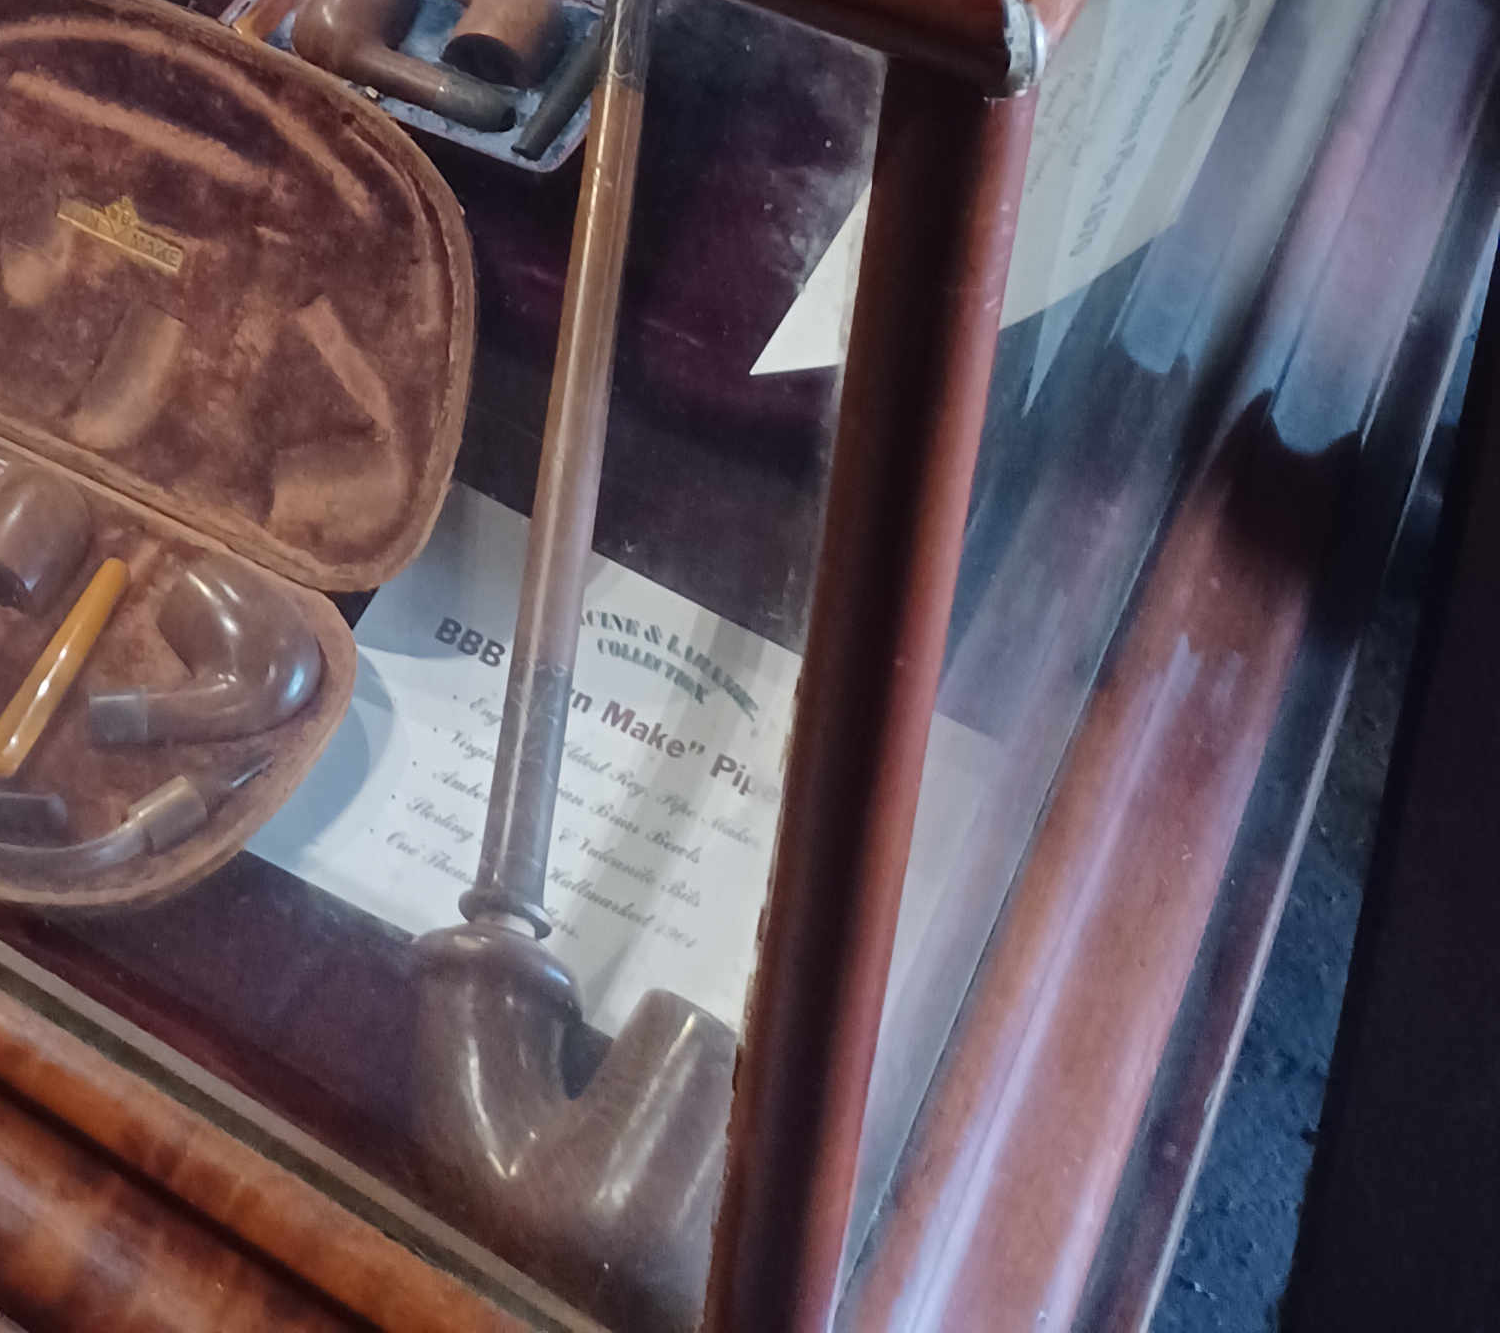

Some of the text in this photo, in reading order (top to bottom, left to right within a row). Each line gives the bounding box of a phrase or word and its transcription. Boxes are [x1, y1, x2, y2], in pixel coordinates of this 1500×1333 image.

[434, 616, 507, 669] BBB
[597, 637, 709, 706] COLLECTION
[644, 620, 662, 644] &
[667, 633, 760, 723] LARAMIE
[600, 700, 706, 760] Make"
